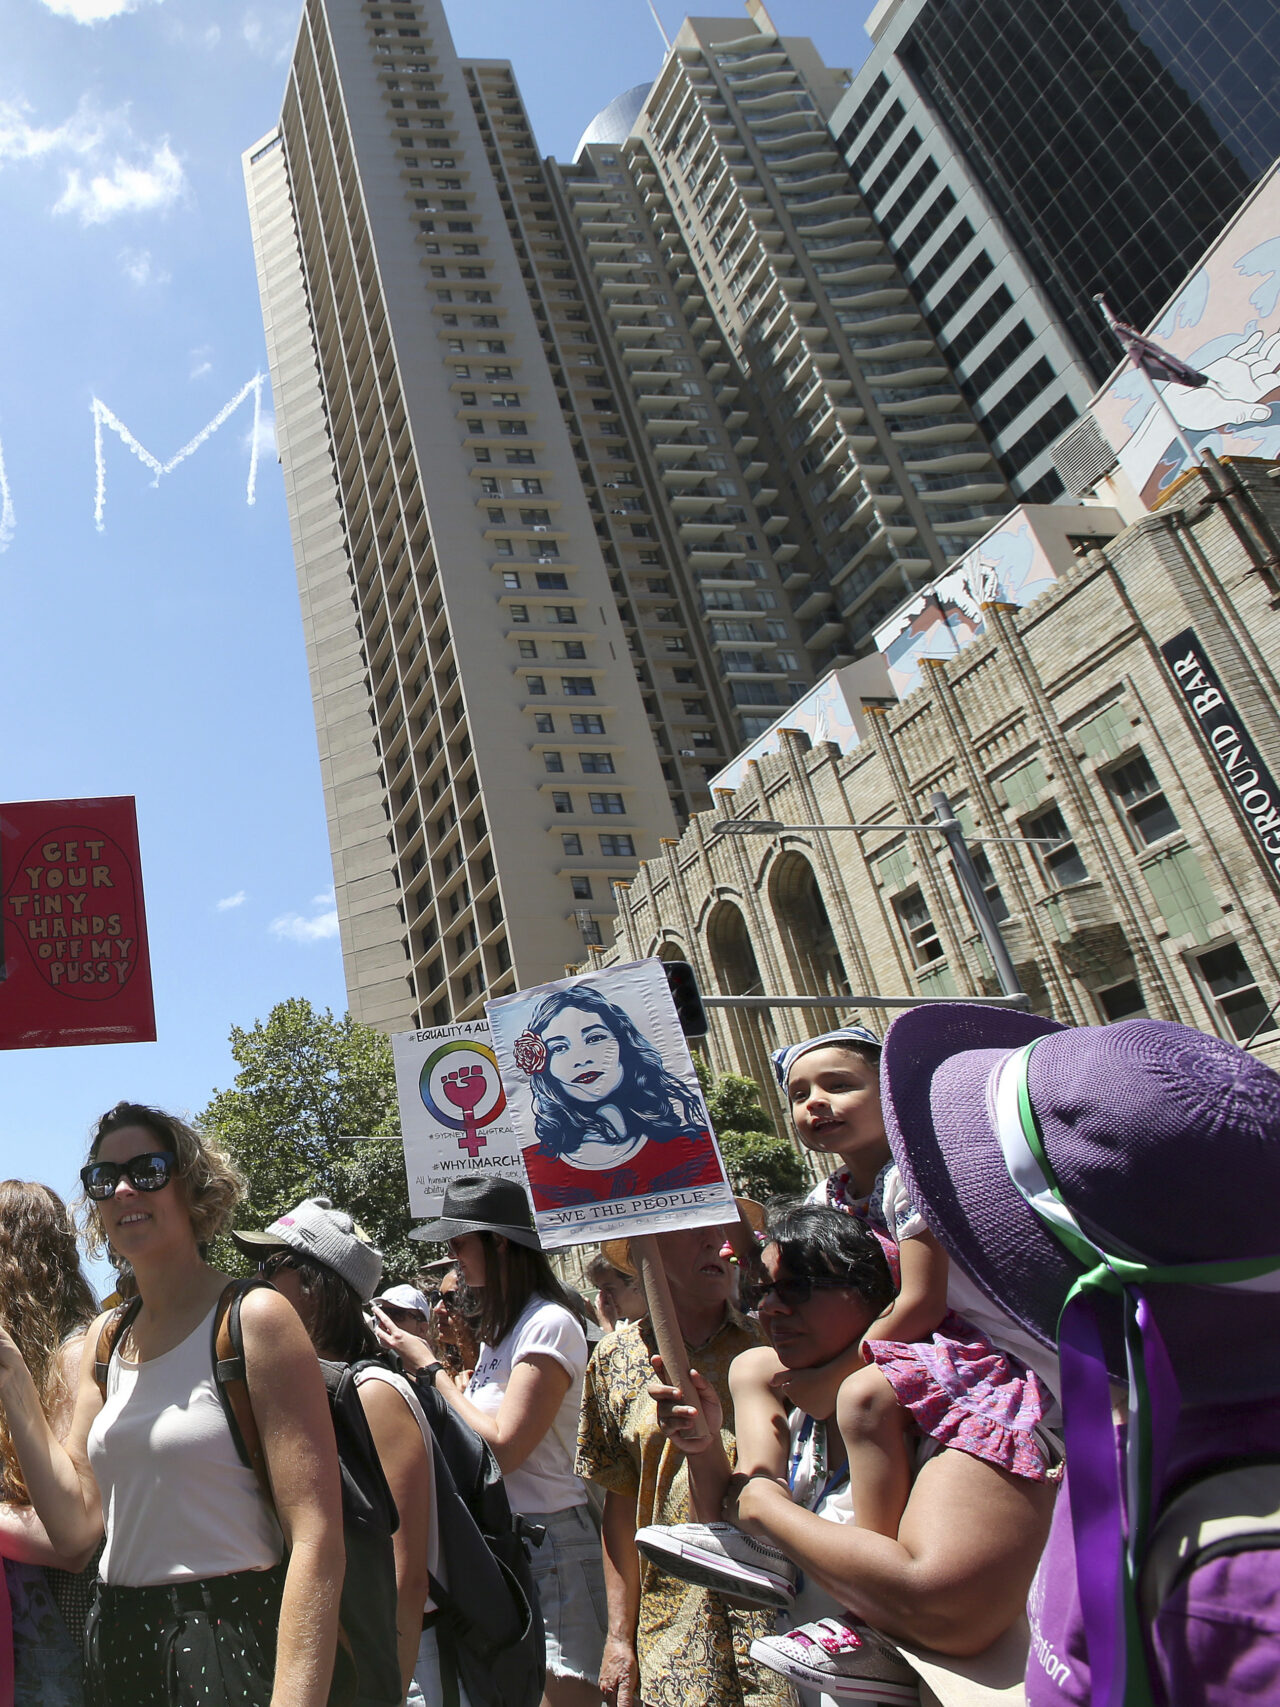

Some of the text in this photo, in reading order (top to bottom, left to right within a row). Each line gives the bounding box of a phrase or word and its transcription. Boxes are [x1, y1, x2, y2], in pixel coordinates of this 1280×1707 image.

[1173, 650, 1226, 719] BAR
[1210, 724, 1280, 876] GROUND
[41, 840, 106, 863] GET
[24, 865, 115, 890] YOUR
[28, 913, 122, 939] HANDS
[38, 938, 134, 960] OFF MY
[49, 960, 132, 985] PUSSY
[408, 1025, 463, 1043] #EQUALITY
[464, 1023, 473, 1034] 4
[556, 1191, 706, 1224] WE THE PEOPLE
